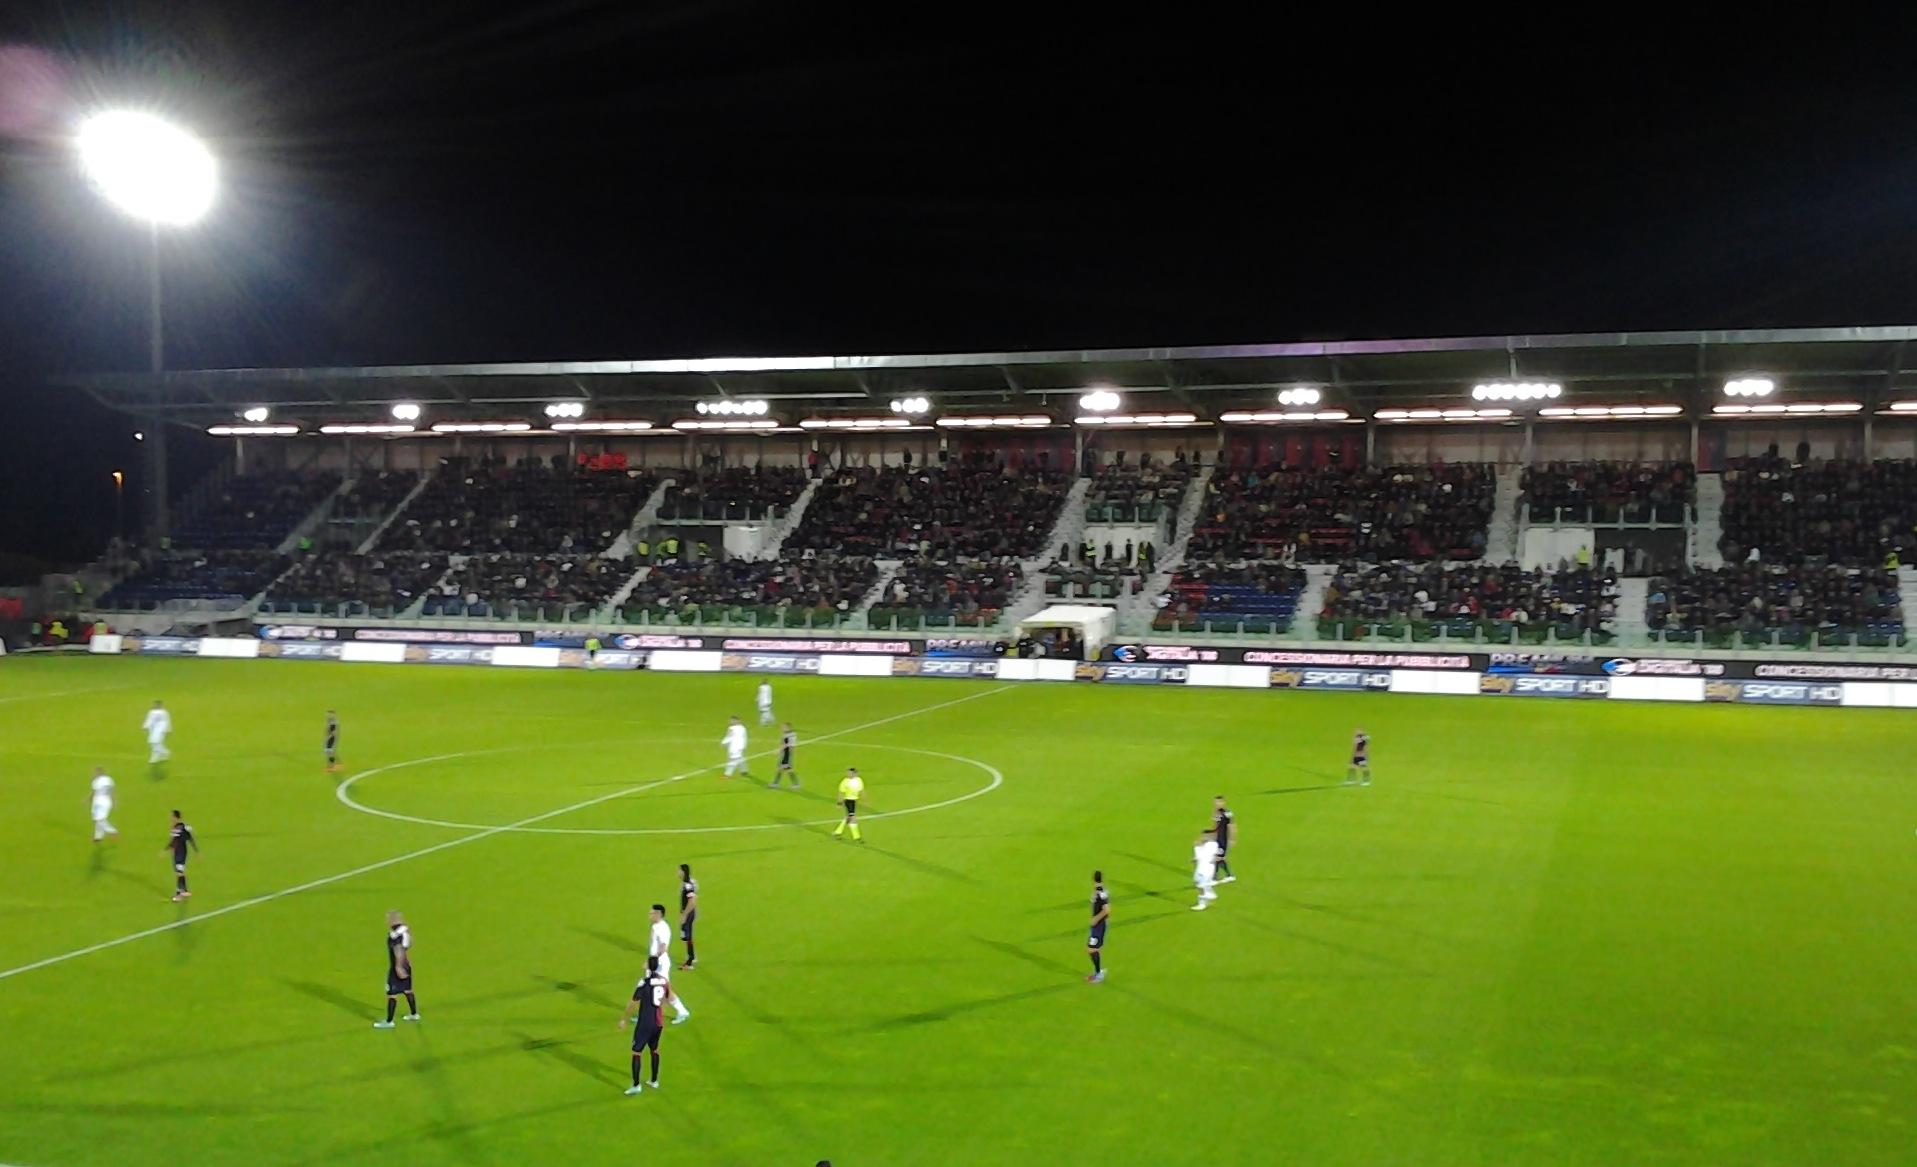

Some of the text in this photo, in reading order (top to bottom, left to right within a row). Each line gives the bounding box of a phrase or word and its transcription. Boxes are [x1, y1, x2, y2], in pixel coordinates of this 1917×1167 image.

[748, 656, 796, 669] SPORT
[920, 660, 973, 673] SPORT
[974, 661, 998, 674] HD
[1106, 666, 1160, 679] SPORT
[1161, 667, 1188, 680] HD
[1303, 671, 1359, 685] SPORT
[1361, 672, 1391, 687] HD
[1515, 678, 1576, 692] SPORT
[1578, 679, 1609, 694] HD
[1742, 684, 1808, 699] SPORT
[1808, 686, 1841, 701] HD
